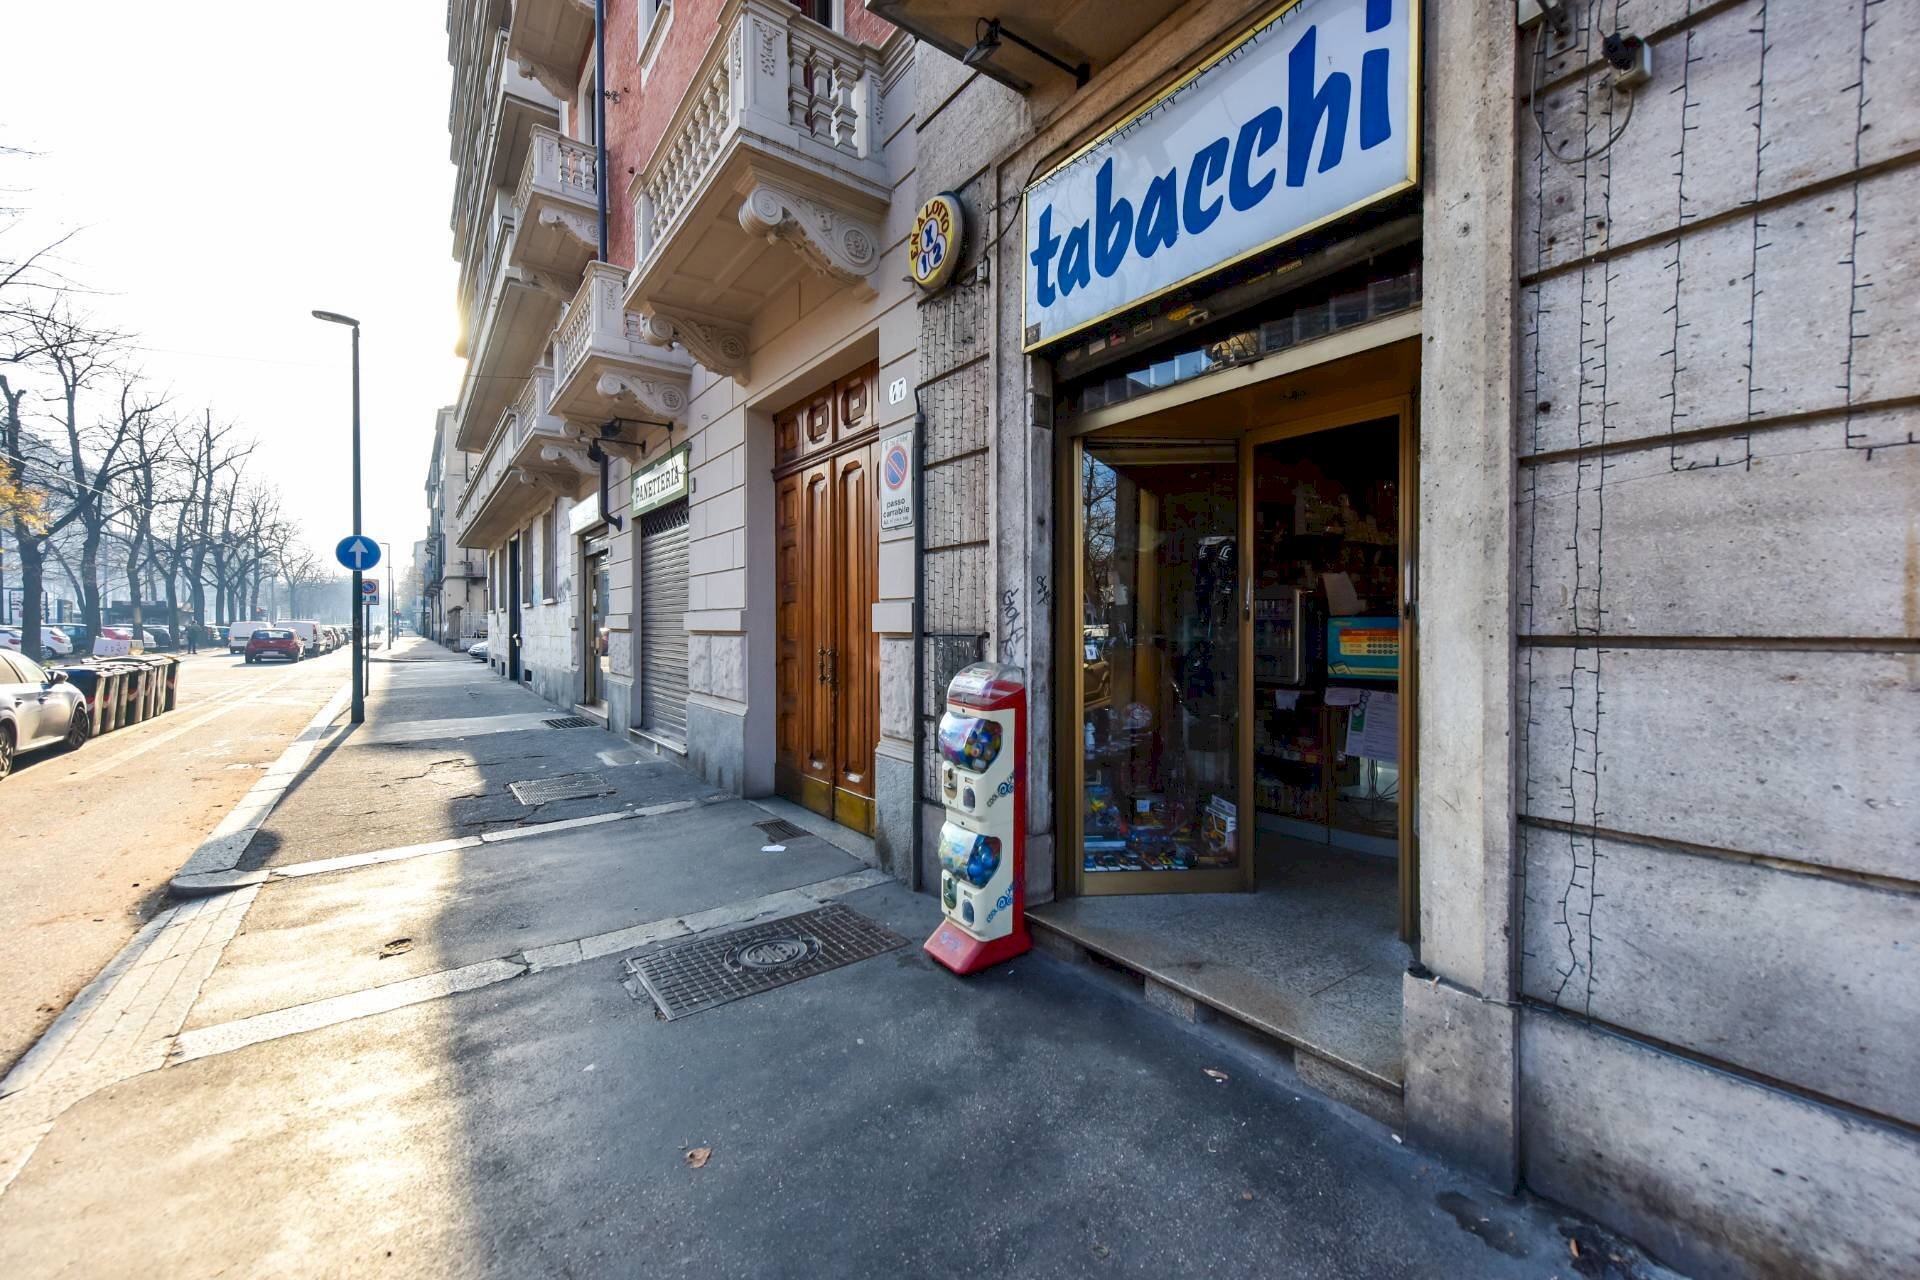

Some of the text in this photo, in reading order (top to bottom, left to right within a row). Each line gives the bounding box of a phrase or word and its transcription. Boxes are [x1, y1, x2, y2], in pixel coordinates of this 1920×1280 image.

[1030, 0, 1391, 307] tabacchi
[910, 200, 950, 261] ENALOTTO
[635, 465, 680, 504] PANETTERIA
[886, 497, 906, 510] passo
[882, 506, 910, 519] carrabile
